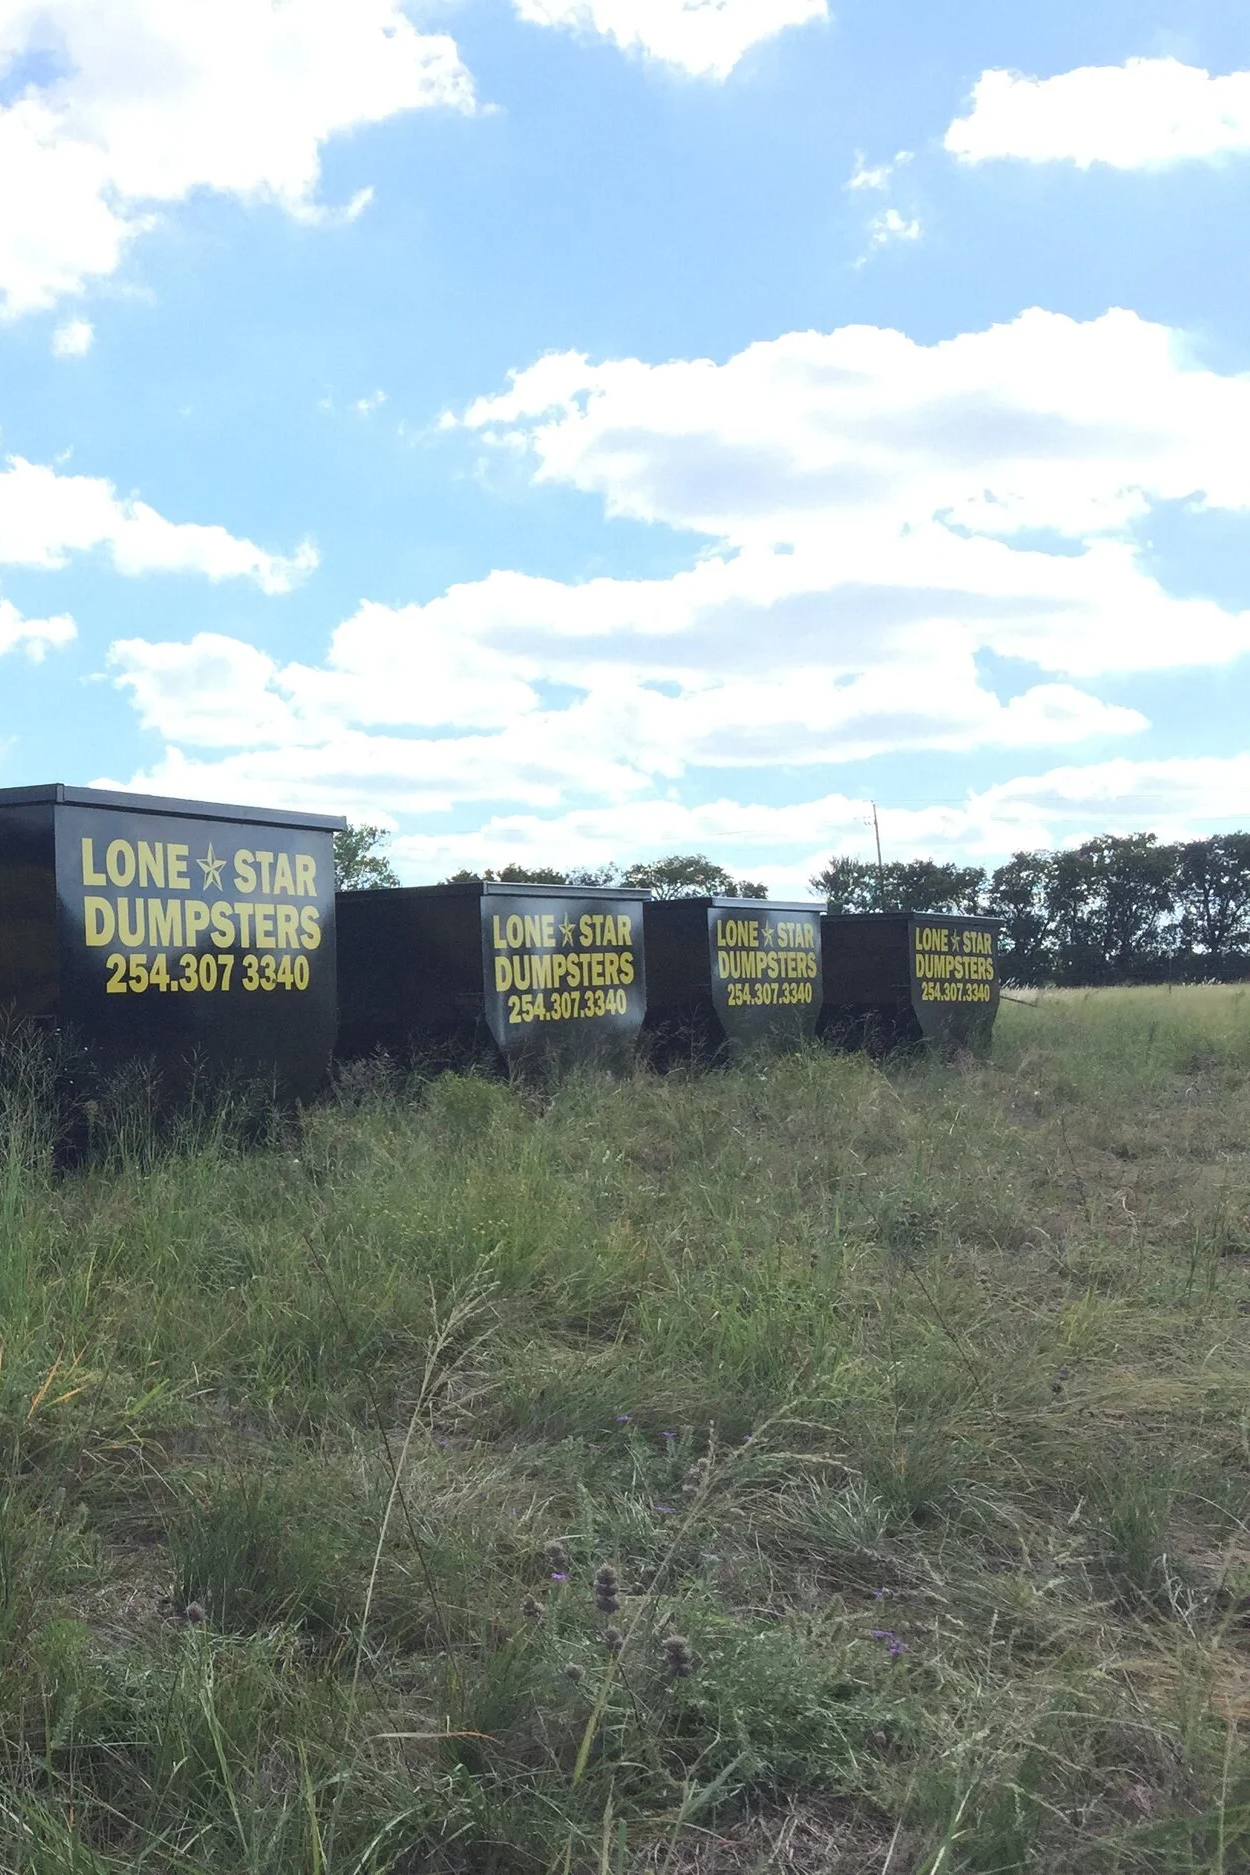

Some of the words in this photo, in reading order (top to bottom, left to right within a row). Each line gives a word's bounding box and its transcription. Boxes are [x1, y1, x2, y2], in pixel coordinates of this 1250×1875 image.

[81, 837, 191, 889] LONE
[233, 849, 318, 897] STAR
[84, 896, 321, 950] DUMPSTERS
[493, 914, 556, 949] LONE
[579, 914, 632, 947] STAR
[717, 920, 759, 947] LONE
[777, 922, 814, 948] STAR
[915, 927, 949, 952] LONE
[962, 931, 992, 954] STAR
[495, 952, 635, 992] DUMPSTERS
[718, 951, 817, 979] DUMPSTERS
[916, 954, 994, 980] DUMPSTERS
[727, 982, 812, 1006] 254.307.3340
[921, 982, 990, 1002] 254.307.3340
[508, 989, 627, 1024] 254.307.3340
